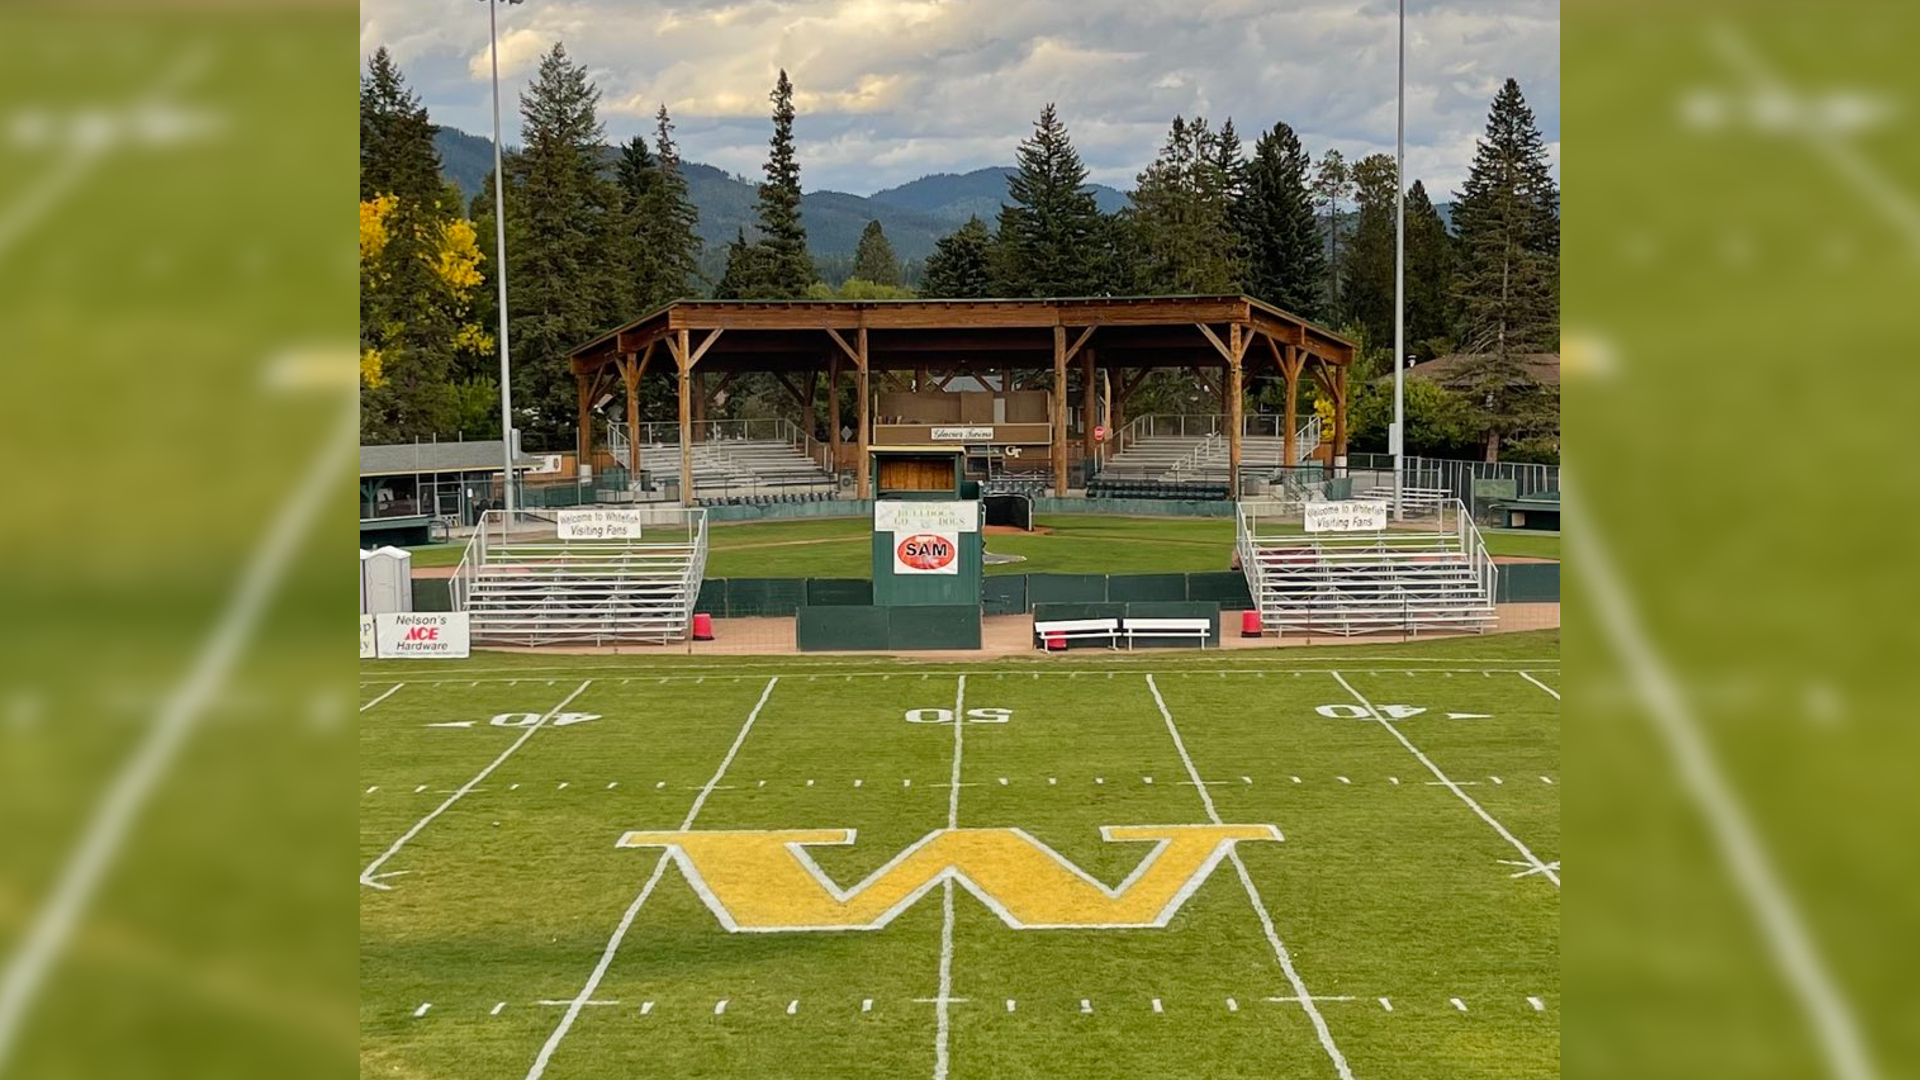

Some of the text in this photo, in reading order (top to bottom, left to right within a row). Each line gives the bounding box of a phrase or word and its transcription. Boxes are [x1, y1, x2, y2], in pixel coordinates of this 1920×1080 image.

[933, 428, 992, 438] Glacier Twins
[1308, 505, 1339, 517] Welcome
[1352, 504, 1385, 516] Whitefish
[560, 512, 638, 524] Welcome to Whitefish
[1318, 516, 1373, 529] Visiting Fans
[571, 524, 628, 537] Visiting Fans
[906, 543, 947, 556] SAM
[396, 615, 448, 626] Nelson's
[405, 627, 440, 640] ACE
[396, 641, 448, 650] Hardware
